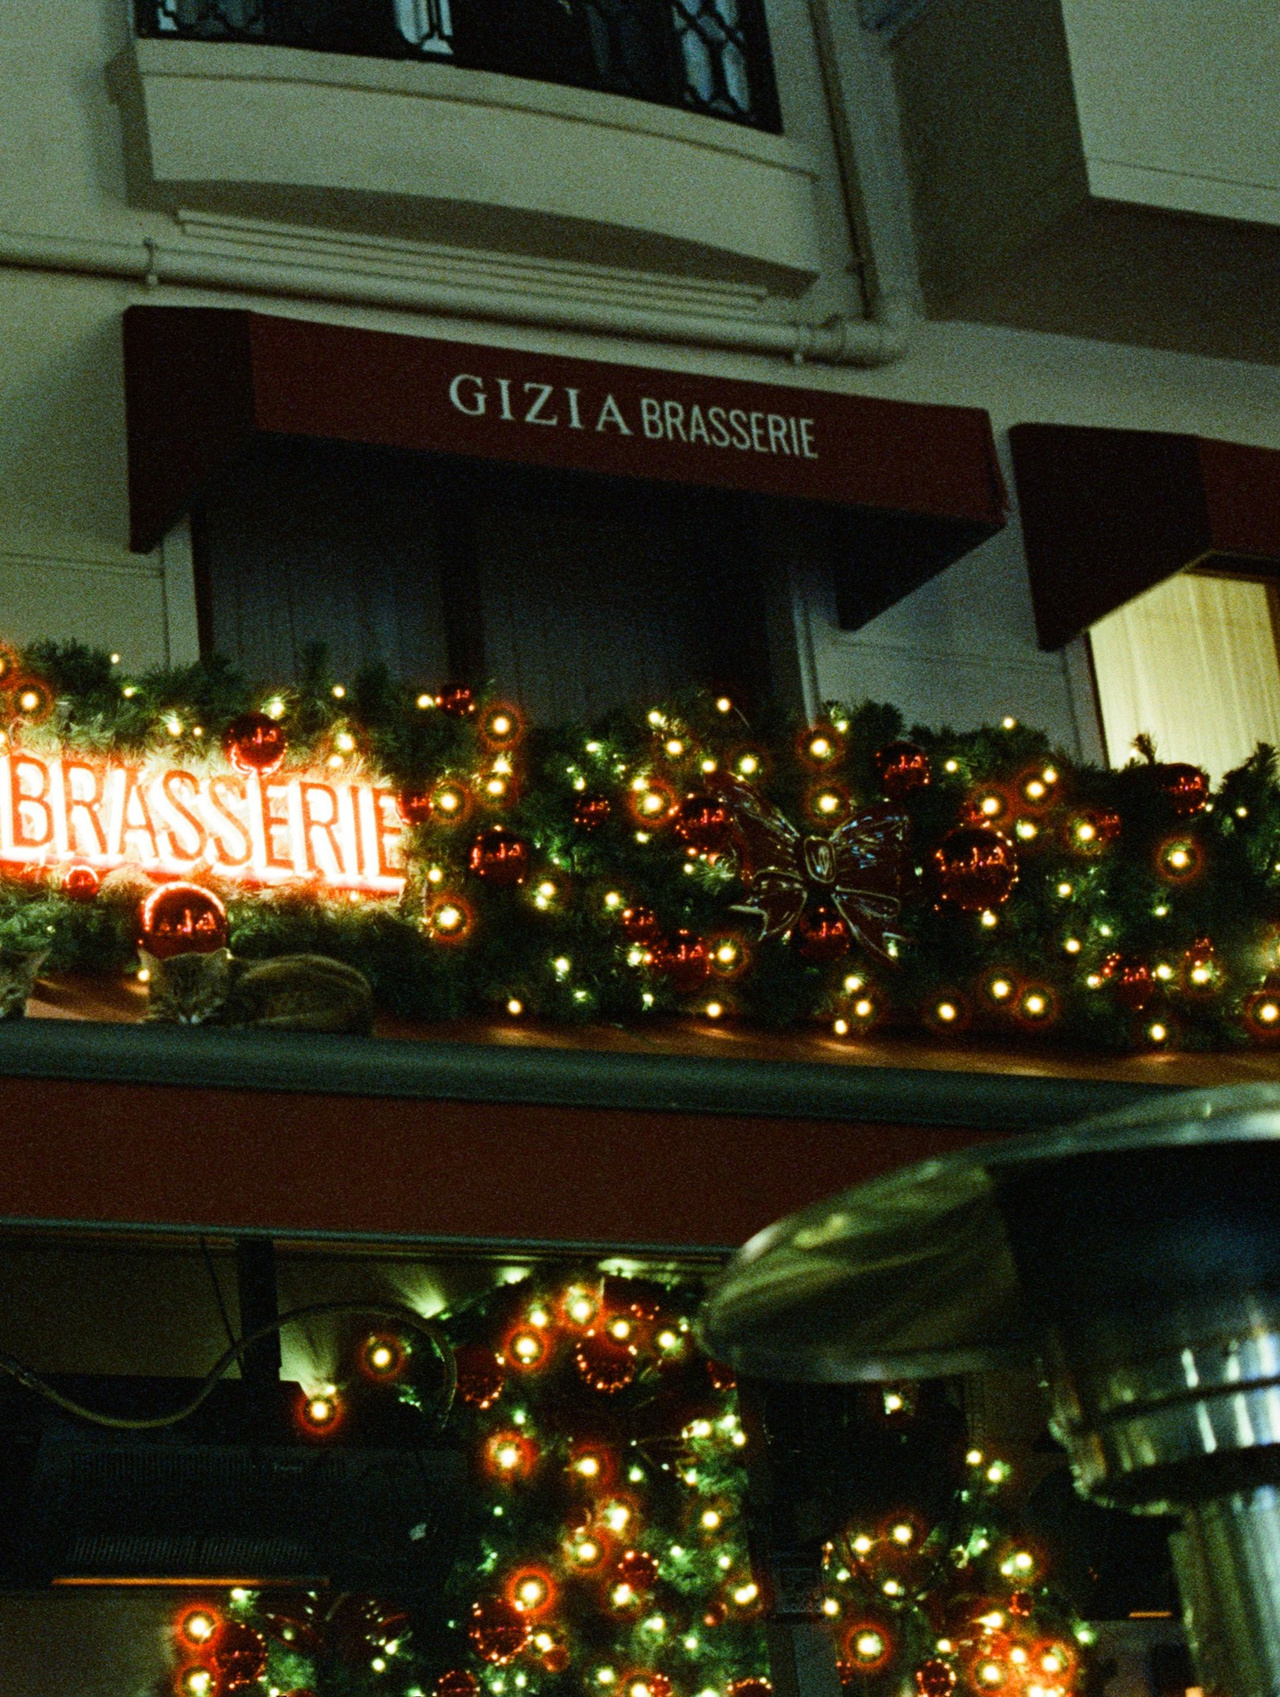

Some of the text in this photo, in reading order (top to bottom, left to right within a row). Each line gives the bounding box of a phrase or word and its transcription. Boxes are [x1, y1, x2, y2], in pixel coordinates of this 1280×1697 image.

[448, 373, 819, 459] GIZIA BRASSERIE
[4, 753, 406, 882] BRASSERIE
